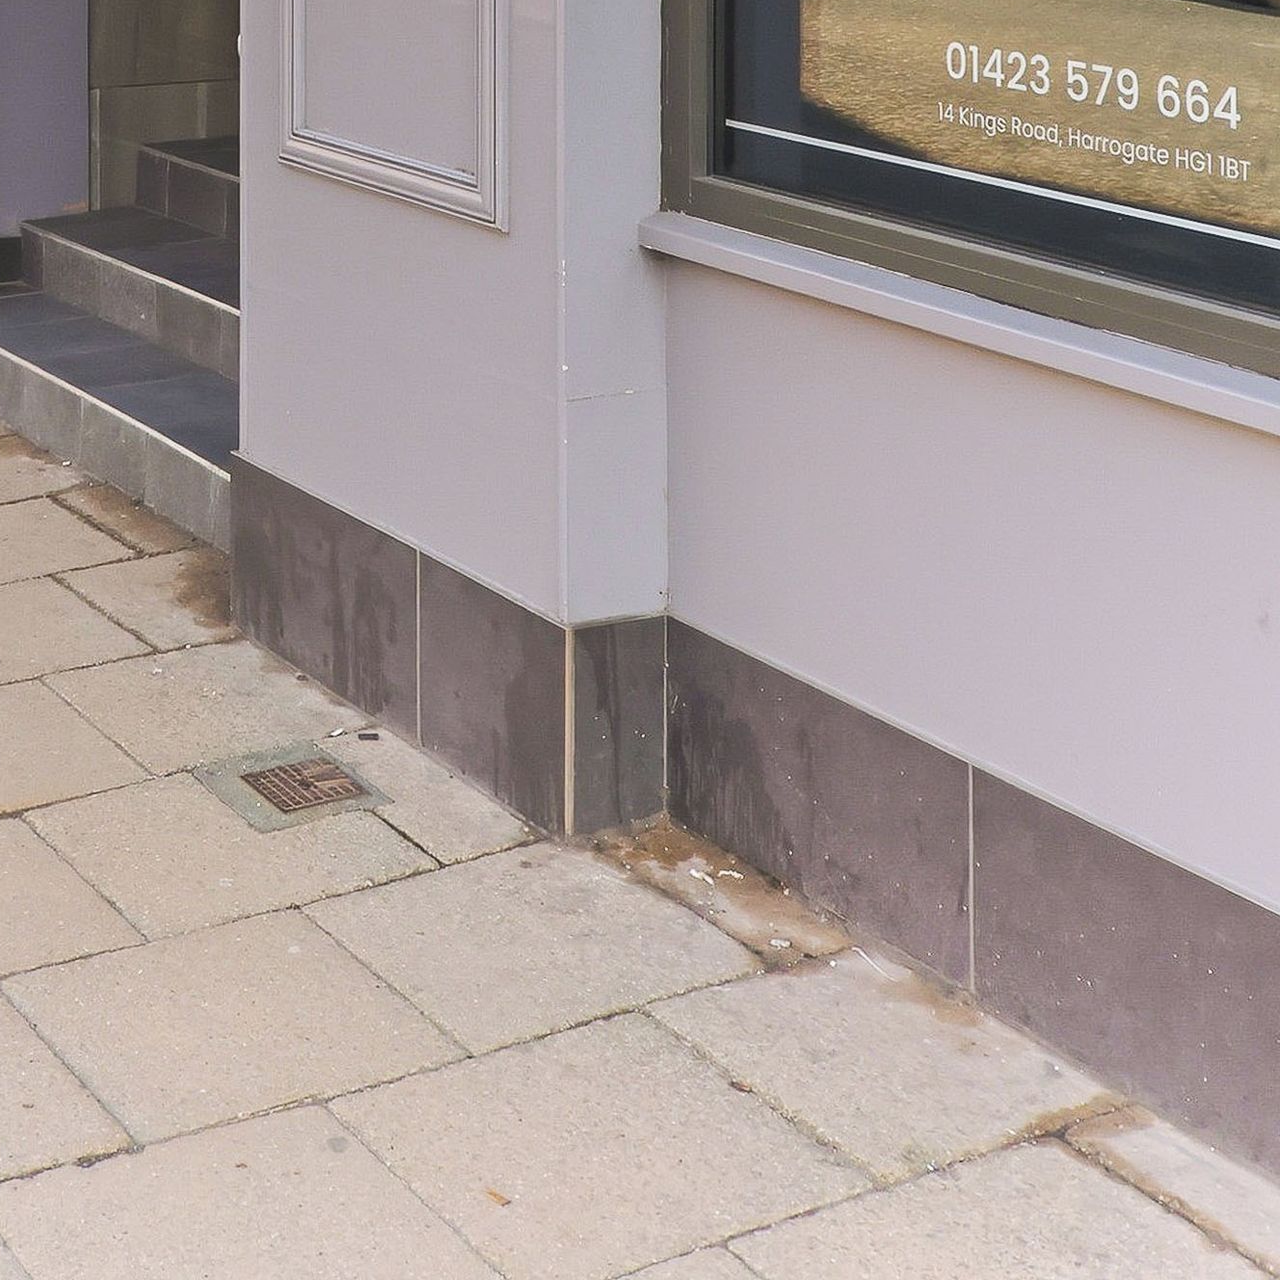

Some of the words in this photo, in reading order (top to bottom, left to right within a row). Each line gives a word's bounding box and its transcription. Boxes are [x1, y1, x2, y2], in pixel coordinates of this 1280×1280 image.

[946, 42, 1051, 95] 01423
[1067, 60, 1140, 111] 579
[1157, 75, 1242, 130] 664
[937, 102, 954, 123] 14
[959, 106, 1006, 138] Kings
[1011, 117, 1063, 147] Road,
[1069, 127, 1169, 164] Harrogate
[1175, 148, 1213, 176] HG1
[1219, 156, 1252, 182] 1BT
